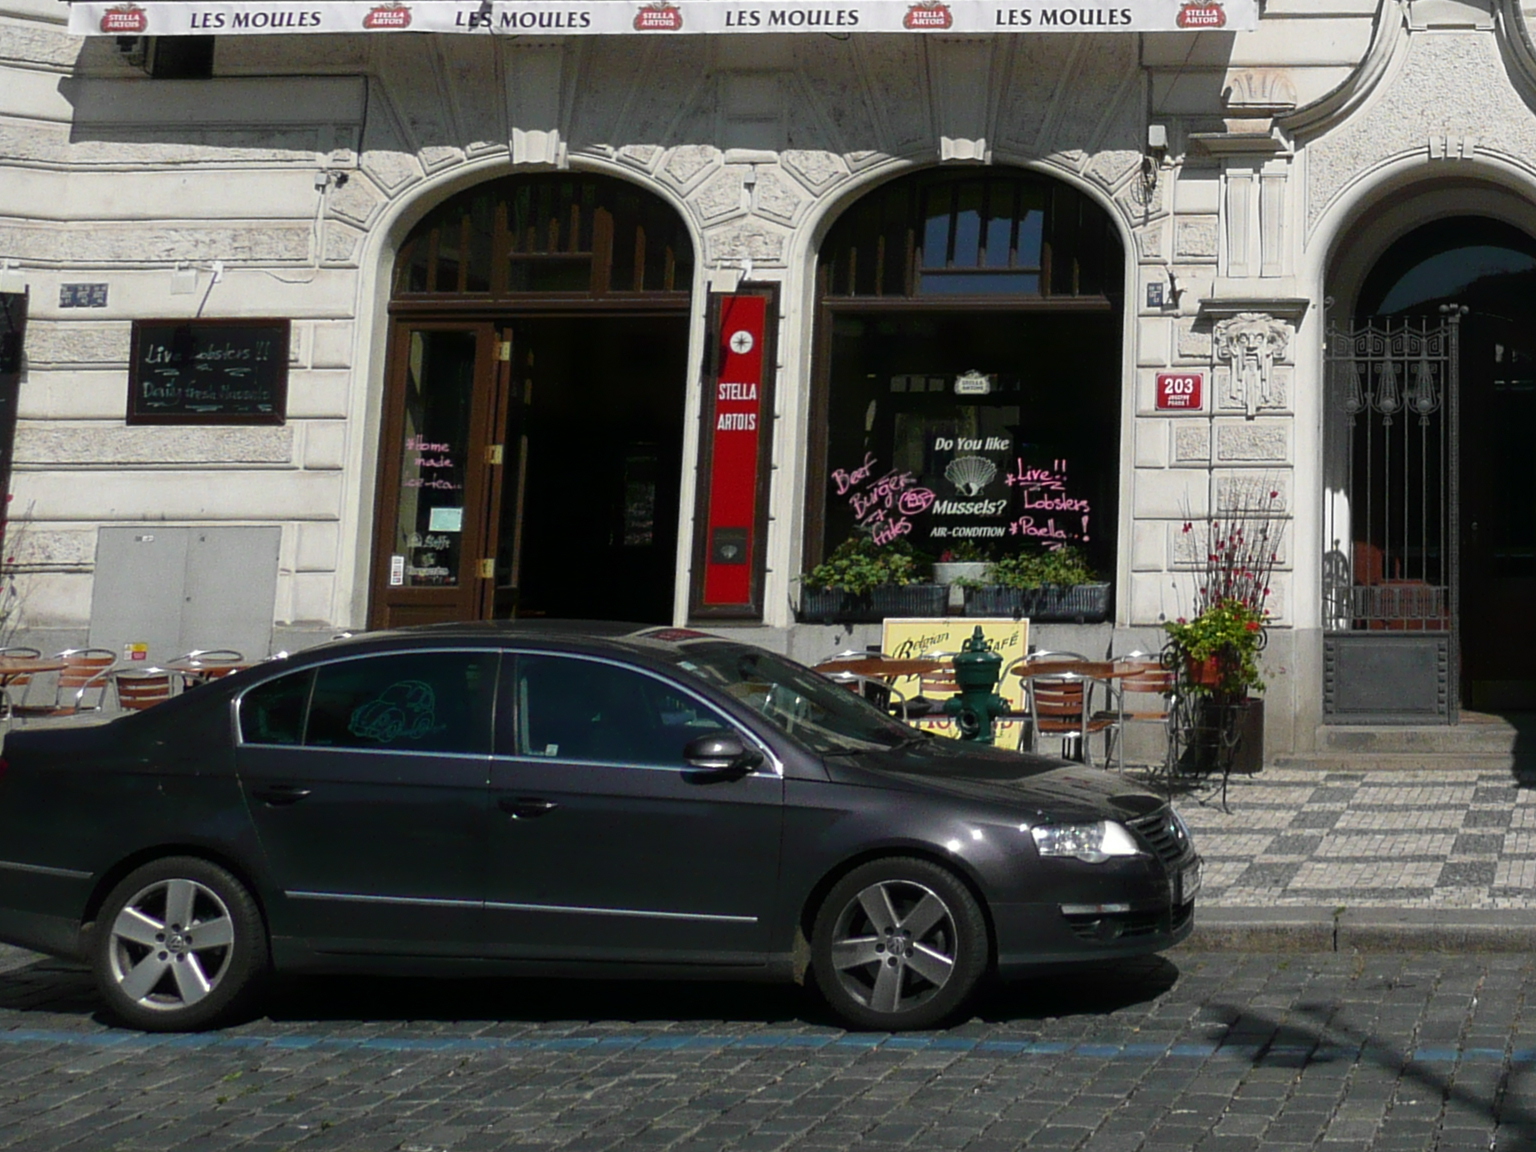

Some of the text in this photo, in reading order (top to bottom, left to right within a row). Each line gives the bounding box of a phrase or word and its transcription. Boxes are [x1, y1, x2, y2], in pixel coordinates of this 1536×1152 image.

[108, 13, 141, 21] STELLA
[190, 11, 322, 29] LES MOULES
[372, 11, 405, 19] STELLA
[455, 11, 591, 28] LES MOULES
[725, 9, 859, 26] LES MOULES
[995, 8, 1132, 26] LES MOULES
[1185, 9, 1218, 17] STELLA
[107, 21, 140, 29] ARTOIS
[370, 18, 404, 26] ARTOIS
[641, 19, 675, 27] ARTOIS
[911, 18, 945, 26] ARTOIS
[1184, 17, 1218, 25] ARTOIS
[719, 382, 757, 400] STELLA
[1164, 378, 1194, 394] 203
[717, 413, 757, 431] ARTOIS
[934, 436, 1010, 451] Do You like
[849, 471, 914, 519] Burger
[1024, 490, 1090, 513] Lobsters
[932, 498, 1007, 516] Mussels?
[929, 526, 1006, 538] AIR-CONDITION
